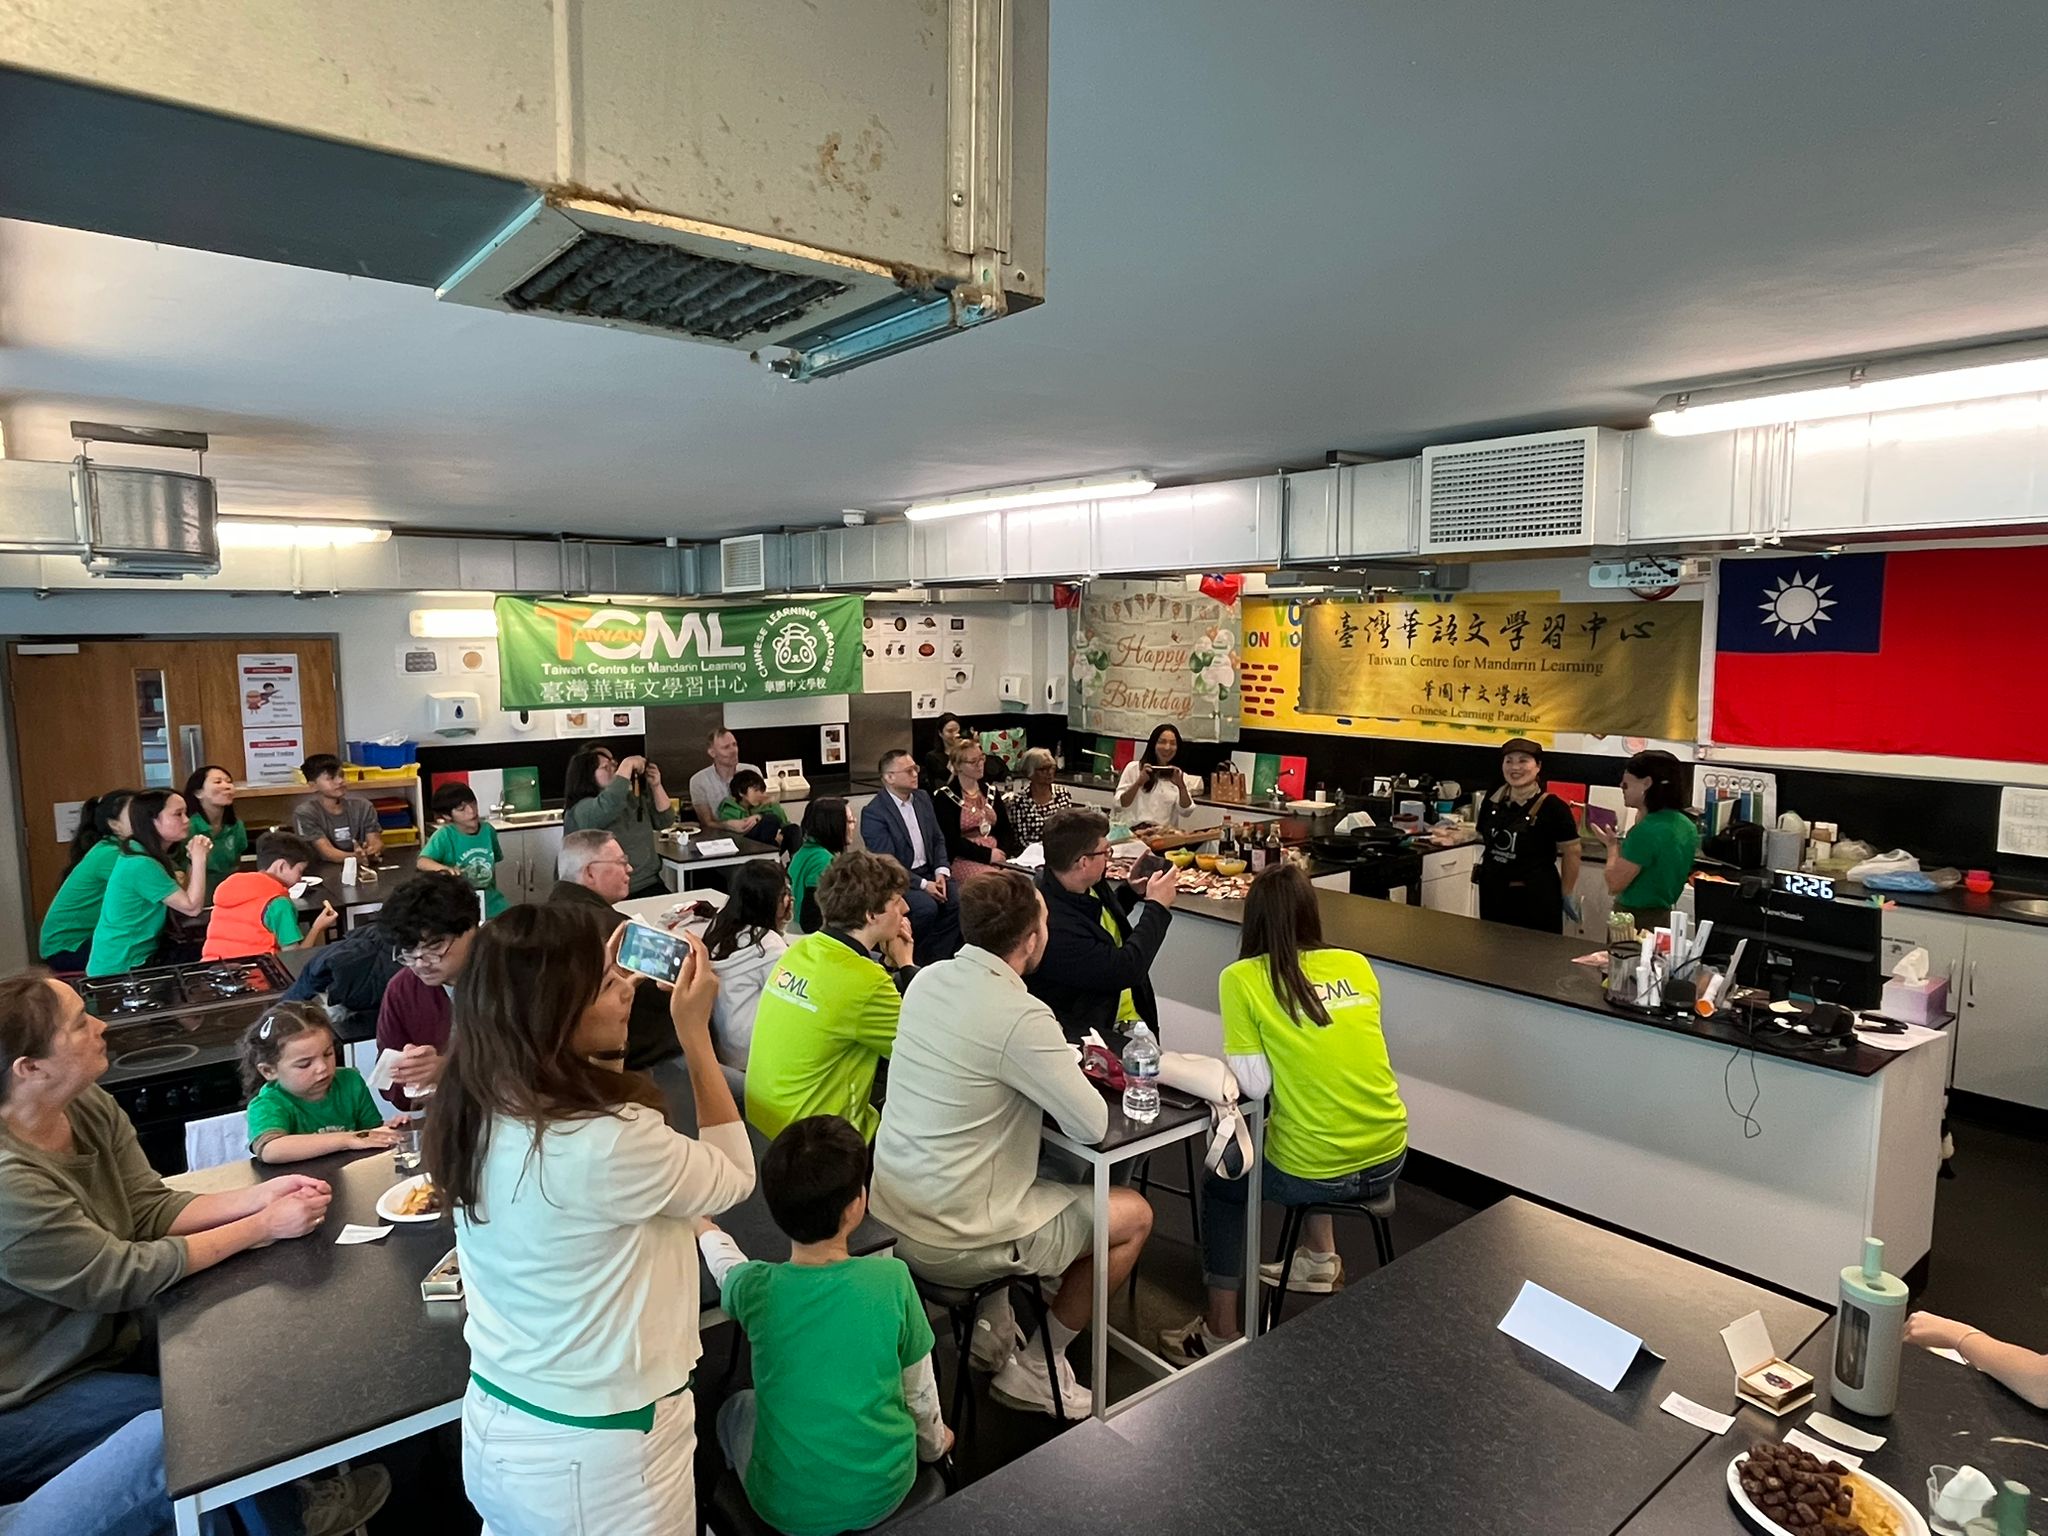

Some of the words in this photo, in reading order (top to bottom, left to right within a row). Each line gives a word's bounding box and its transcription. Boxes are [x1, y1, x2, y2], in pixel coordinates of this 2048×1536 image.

[534, 606, 746, 661] TCML
[753, 626, 769, 678] CHINESE
[765, 606, 818, 626] LEARNING
[817, 618, 835, 674] PARADISE
[1334, 607, 1656, 651] 臺灣華語文學習中心
[541, 663, 585, 675] Taiwan
[587, 662, 628, 675] Centre
[631, 663, 645, 674] for
[648, 661, 698, 673] Mandarin
[701, 660, 747, 673] Learning
[1109, 633, 1188, 673] Happy
[1368, 652, 1407, 668] Taiwan
[1410, 653, 1450, 669] Centre
[1453, 654, 1472, 669] for
[1473, 656, 1537, 672] Mandarin
[1540, 658, 1604, 676] Learning
[540, 674, 748, 705] 臺灣華語文學習中心
[1100, 679, 1194, 720] Birthday
[1410, 703, 1449, 718] Chinese
[1450, 706, 1495, 722] Learning
[1497, 710, 1541, 724] Paradise
[1785, 875, 1834, 899] 12:26
